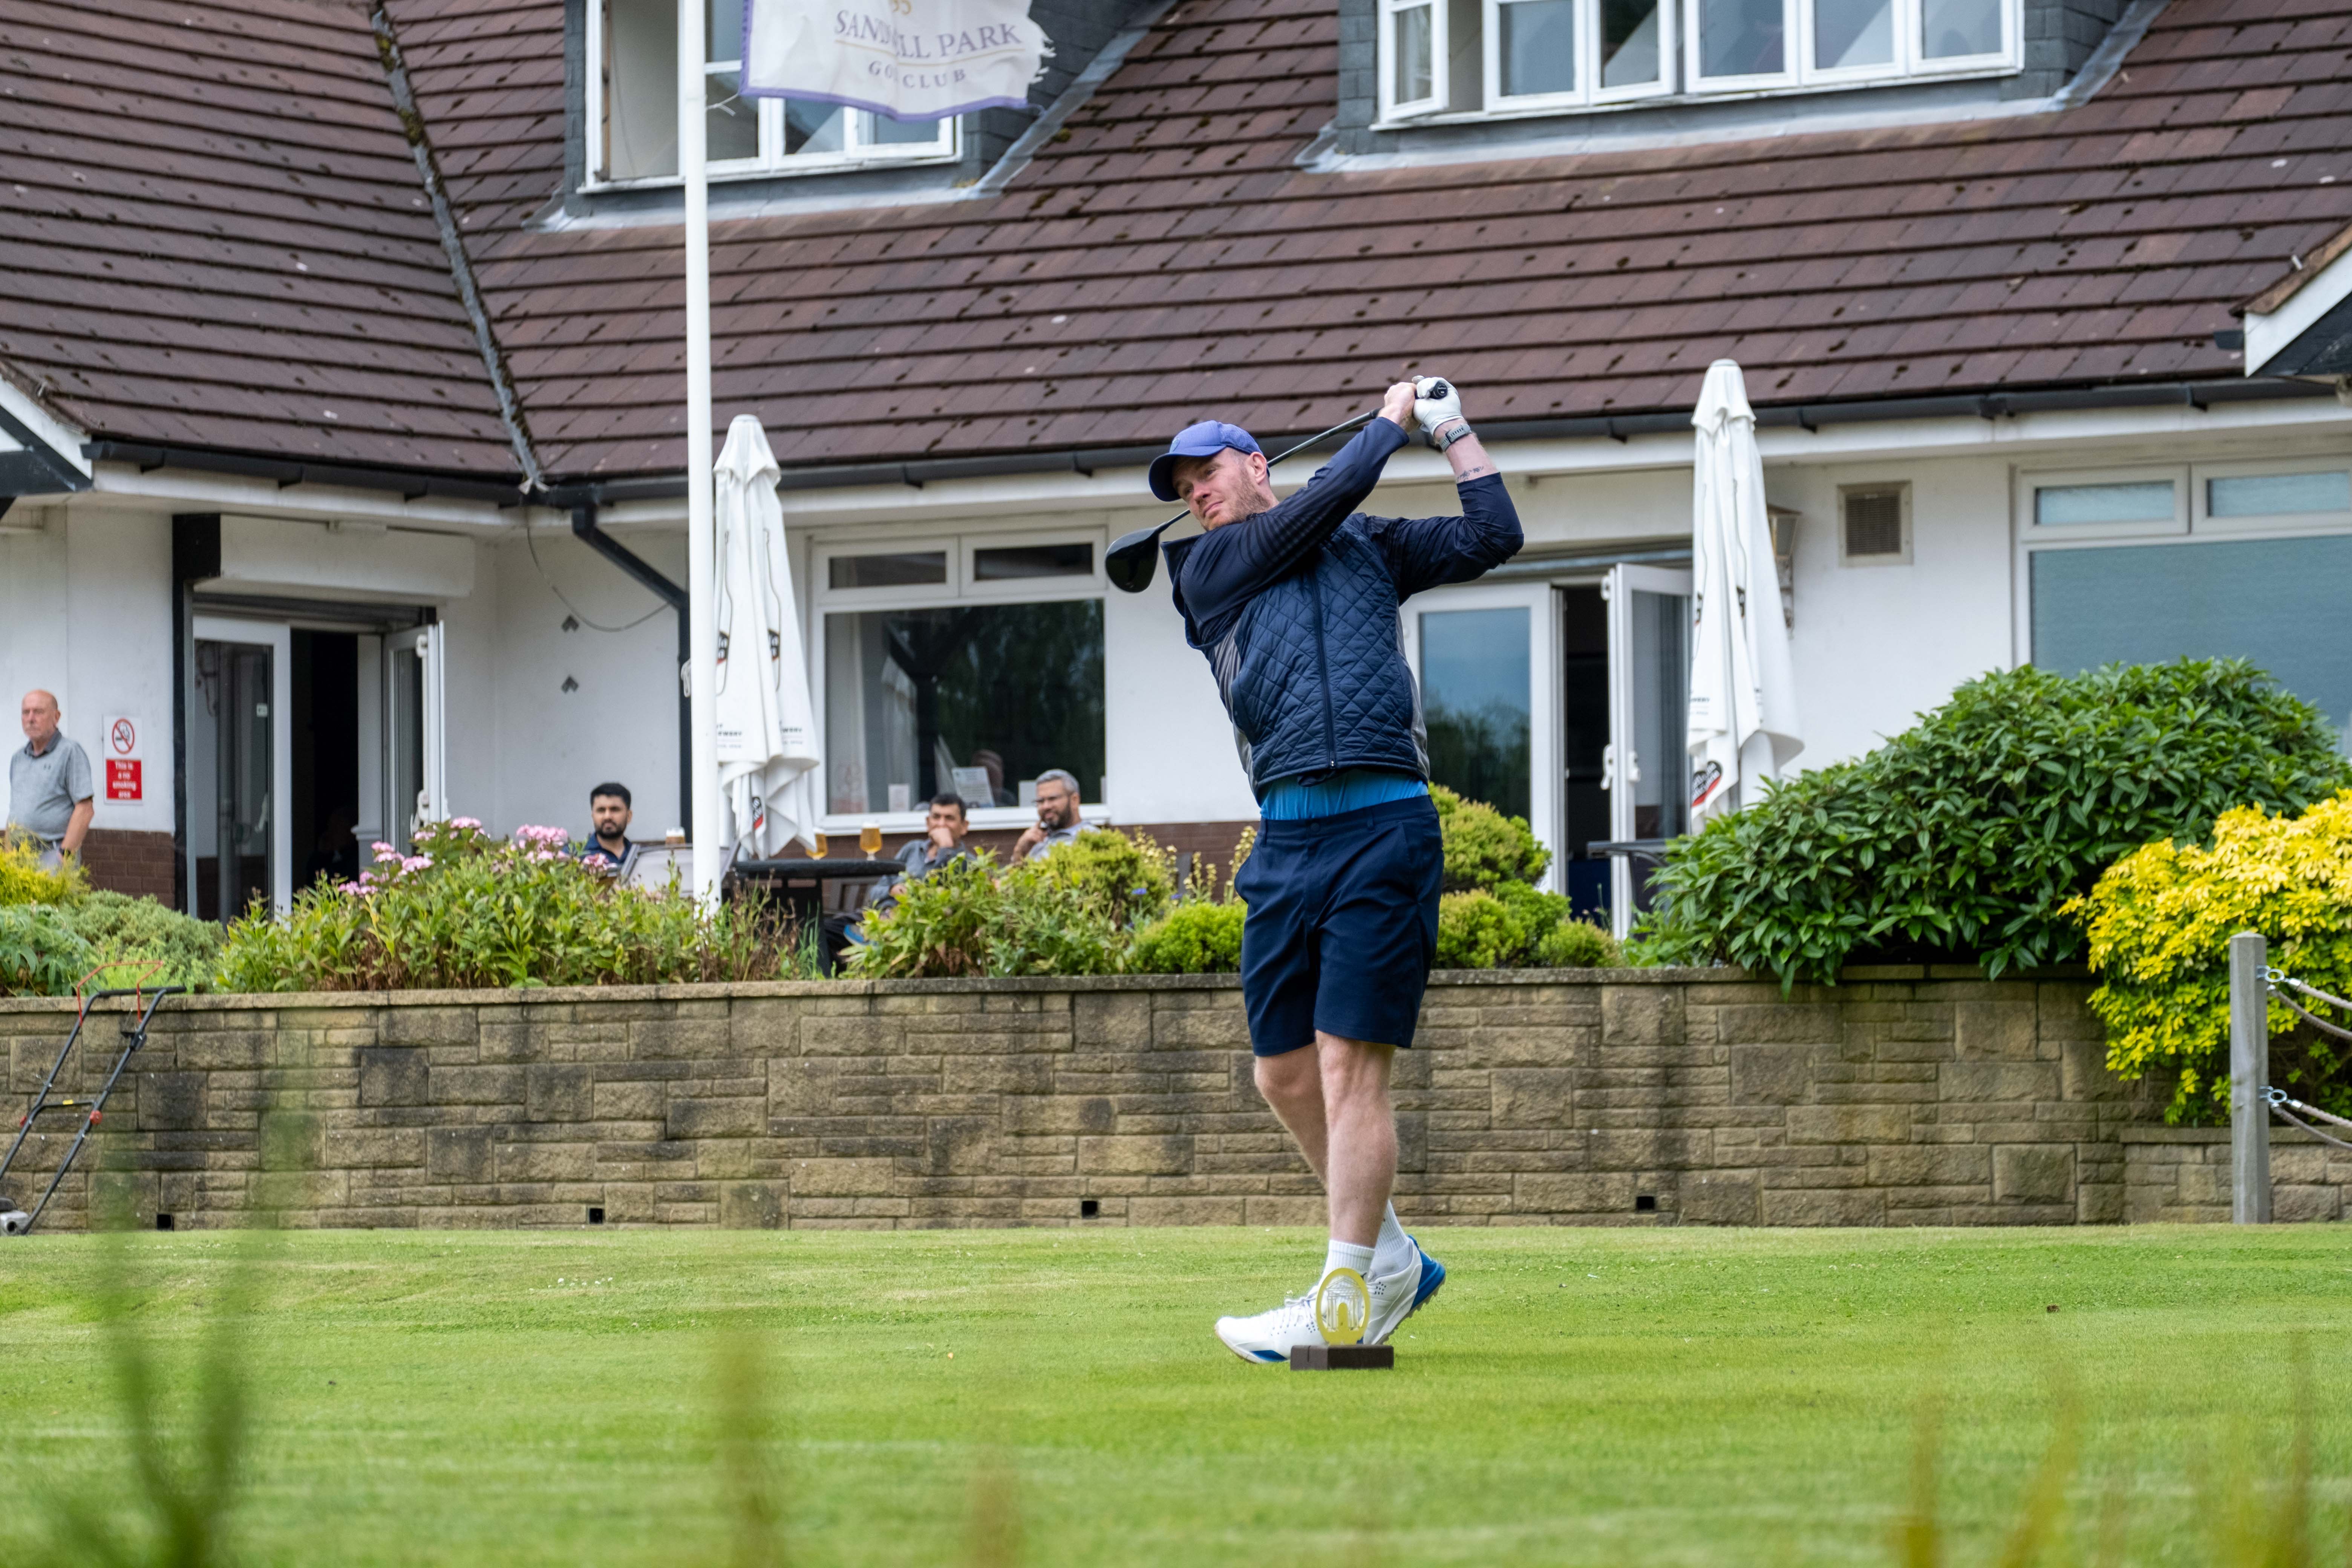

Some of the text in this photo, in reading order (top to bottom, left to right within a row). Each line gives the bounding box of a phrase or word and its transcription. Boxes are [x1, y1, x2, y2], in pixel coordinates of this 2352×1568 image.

[936, 23, 1022, 57] PARK
[903, 69, 966, 89] CLUB
[112, 780, 136, 791] smoking
